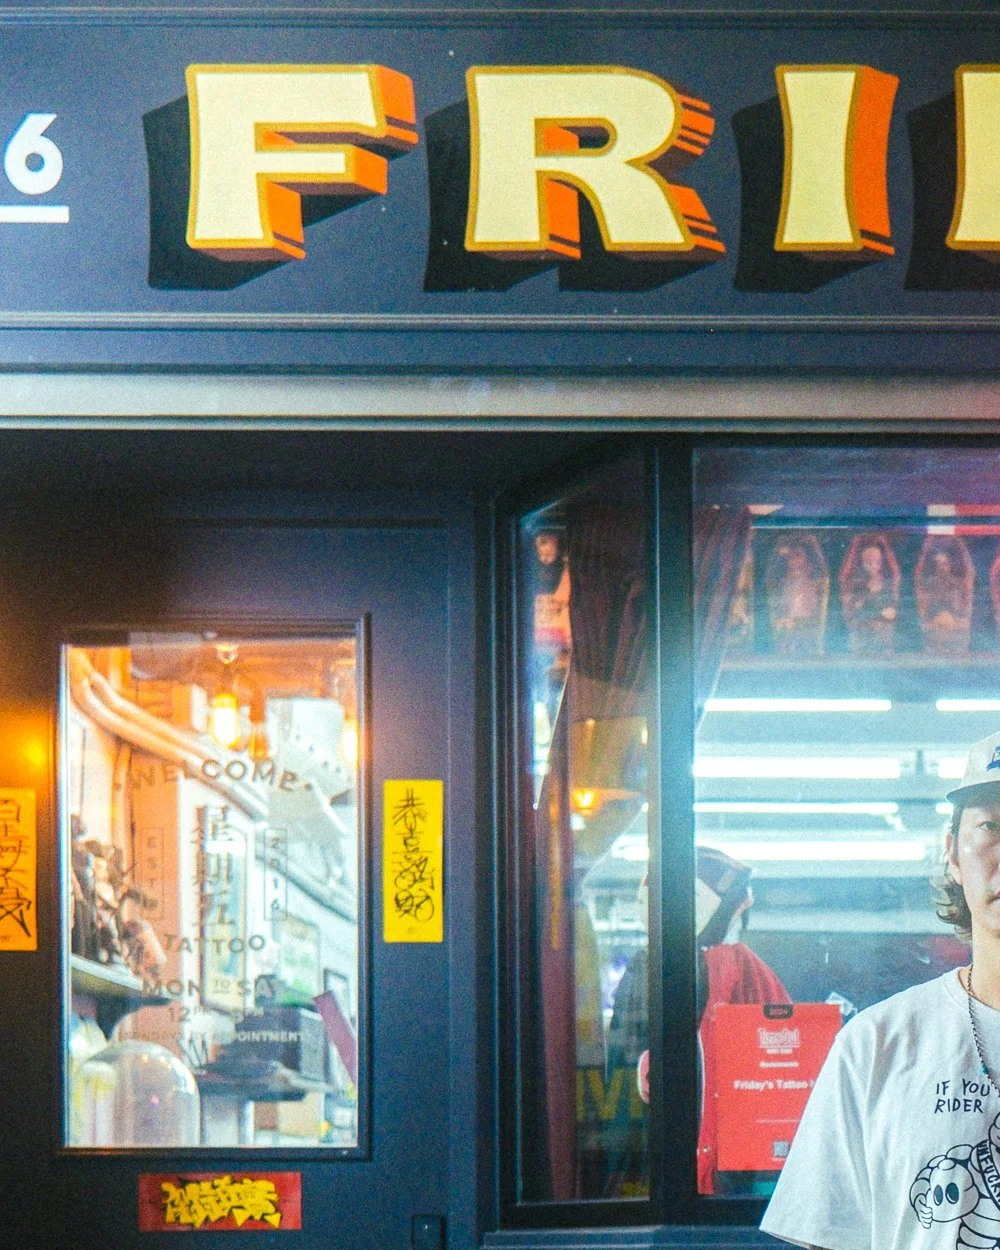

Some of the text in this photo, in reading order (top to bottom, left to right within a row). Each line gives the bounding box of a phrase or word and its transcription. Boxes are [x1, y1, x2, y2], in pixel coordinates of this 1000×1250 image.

[3, 113, 64, 195] 6
[164, 934, 266, 954] TATTOO
[936, 1080, 951, 1096] IF
[962, 1078, 991, 1097] YOU
[934, 1099, 984, 1114] RIDER
